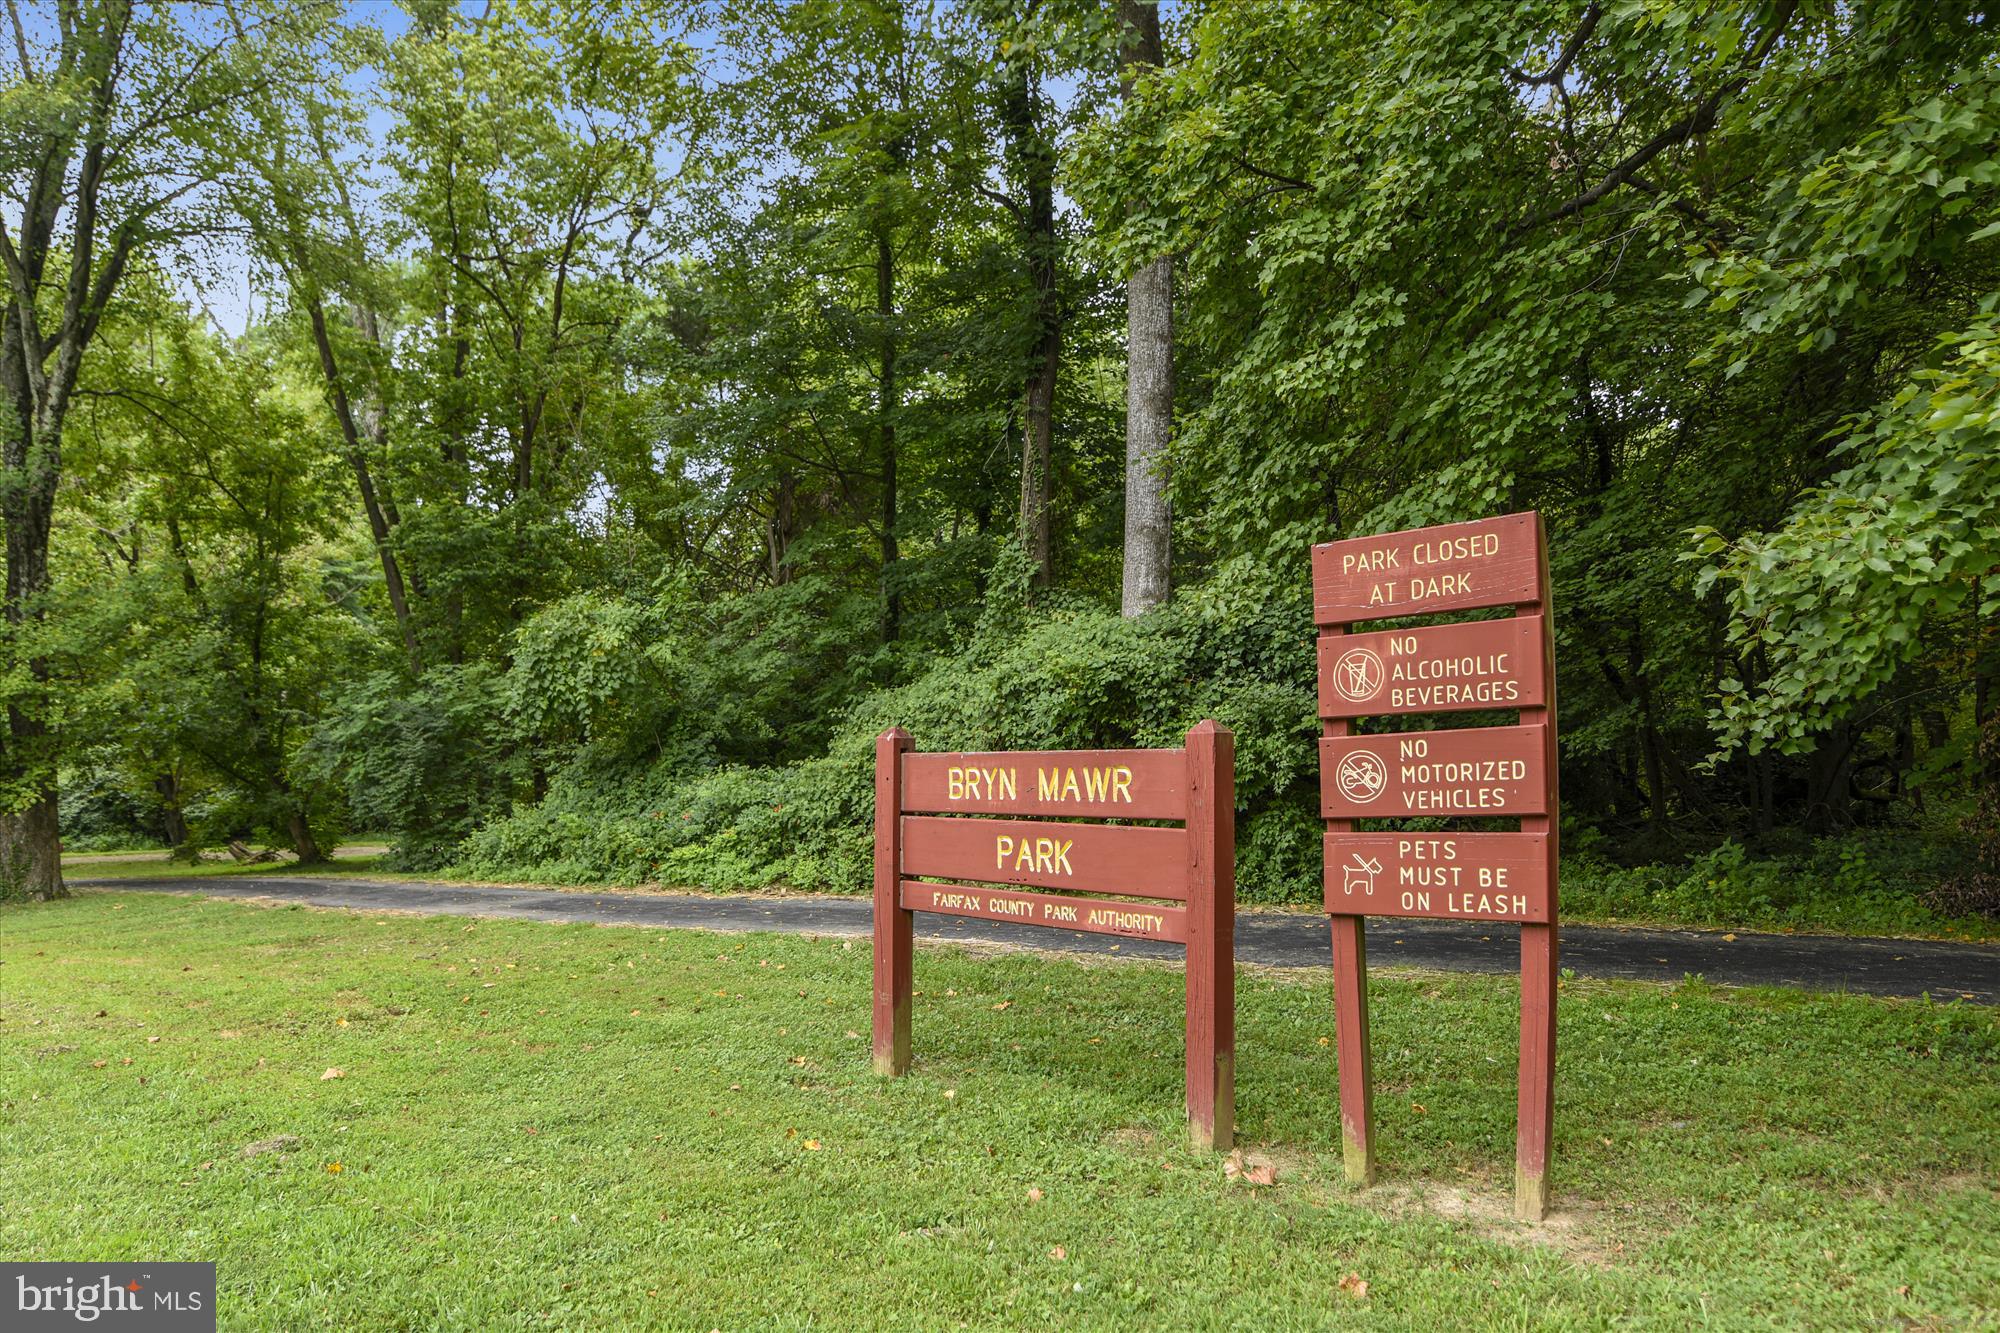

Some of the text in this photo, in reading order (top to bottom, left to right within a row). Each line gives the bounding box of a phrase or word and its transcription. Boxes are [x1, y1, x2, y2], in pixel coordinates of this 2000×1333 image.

[1343, 534, 1499, 575] PARK CLOSED
[1370, 573, 1471, 604] AT DARK
[1390, 636, 1417, 655] NO
[1392, 654, 1508, 681] ALCOHOLIC
[1391, 681, 1518, 707] BEVERAGES
[1400, 740, 1428, 758] NO
[948, 765, 1133, 803] BRYN MAWR
[1401, 761, 1526, 784] MOTORIZED
[1403, 788, 1505, 809] VEHICLES
[996, 835, 1073, 876] PARK
[1399, 841, 1456, 859] PETS
[1400, 867, 1508, 888] MUST BE
[932, 892, 1163, 932] FAIRFAX COUNTY PARK AUTHORITY
[1401, 892, 1526, 914] ON LEASH
